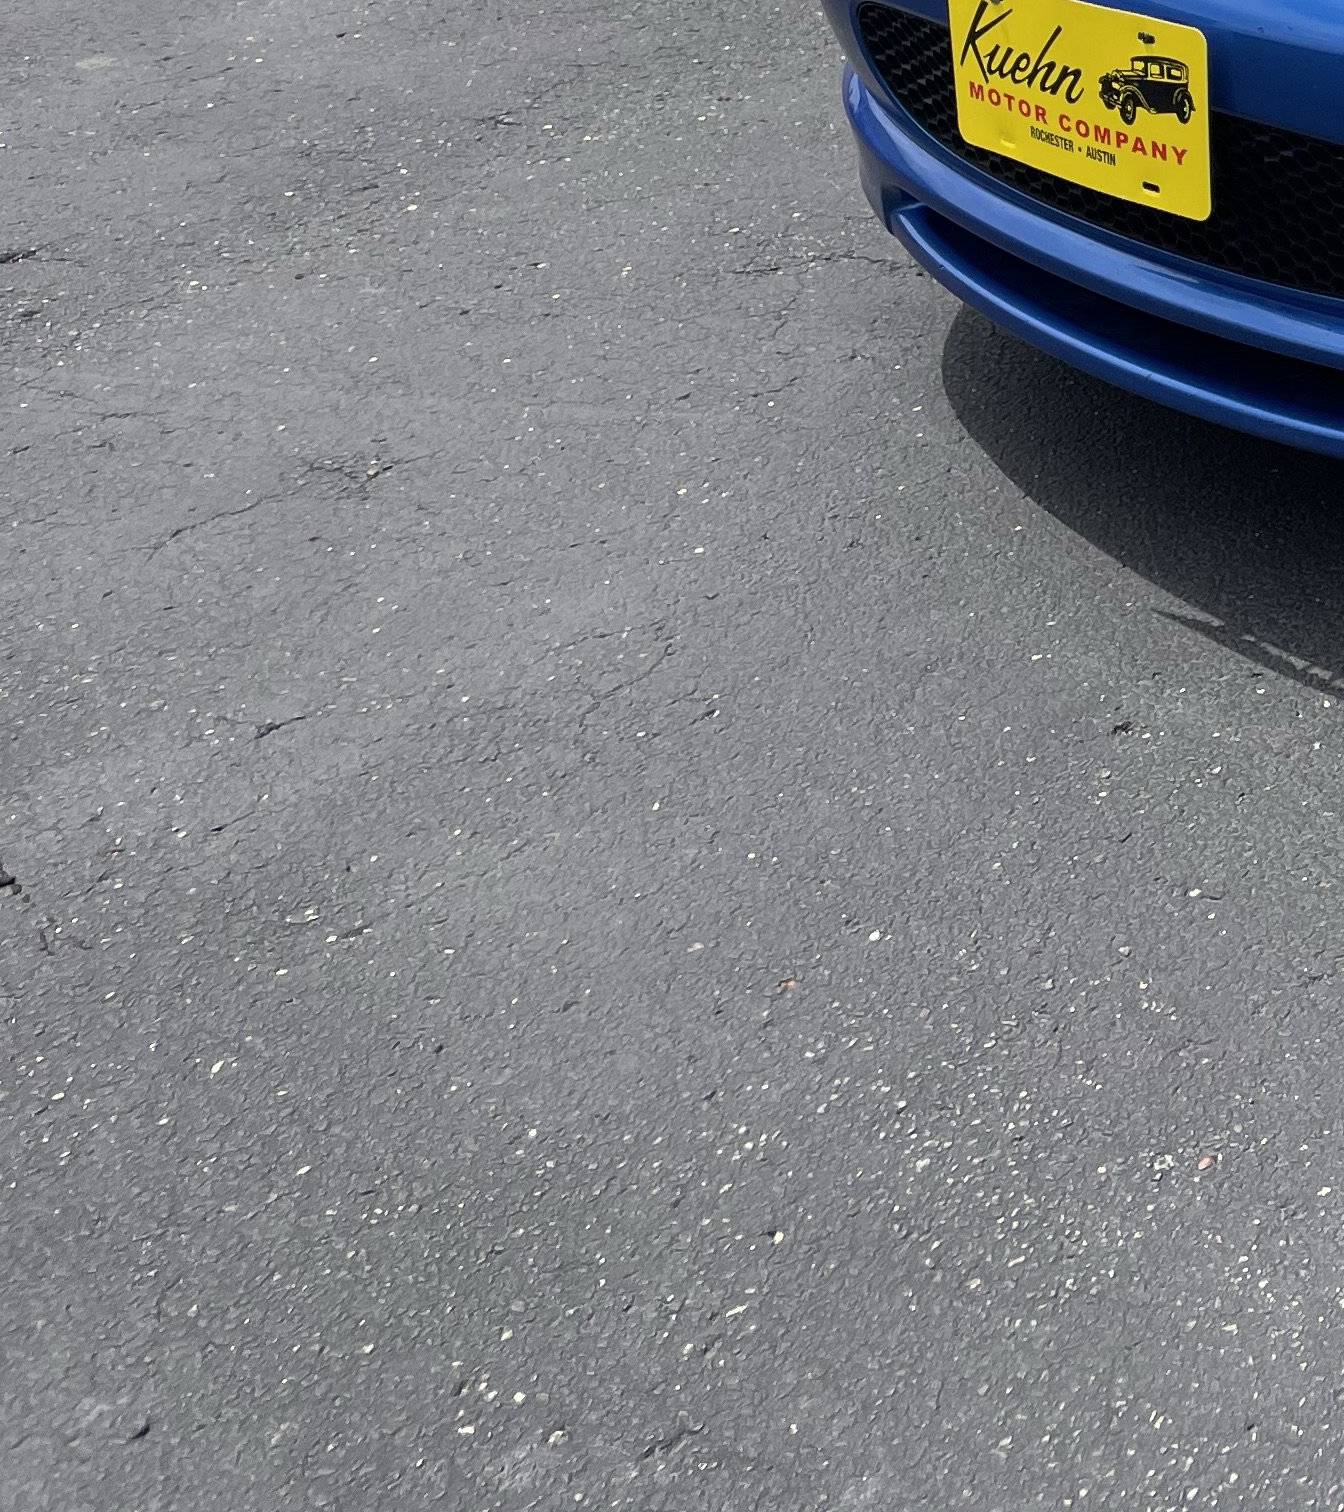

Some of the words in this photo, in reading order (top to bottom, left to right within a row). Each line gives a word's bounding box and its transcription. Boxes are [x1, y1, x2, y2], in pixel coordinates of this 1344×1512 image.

[959, 0, 1085, 105] Kuehn
[968, 81, 1049, 125] MOTOR
[1058, 114, 1189, 166] COMPANY
[1030, 126, 1075, 153] ROCHESTER
[1086, 145, 1117, 166] AUSTIN
